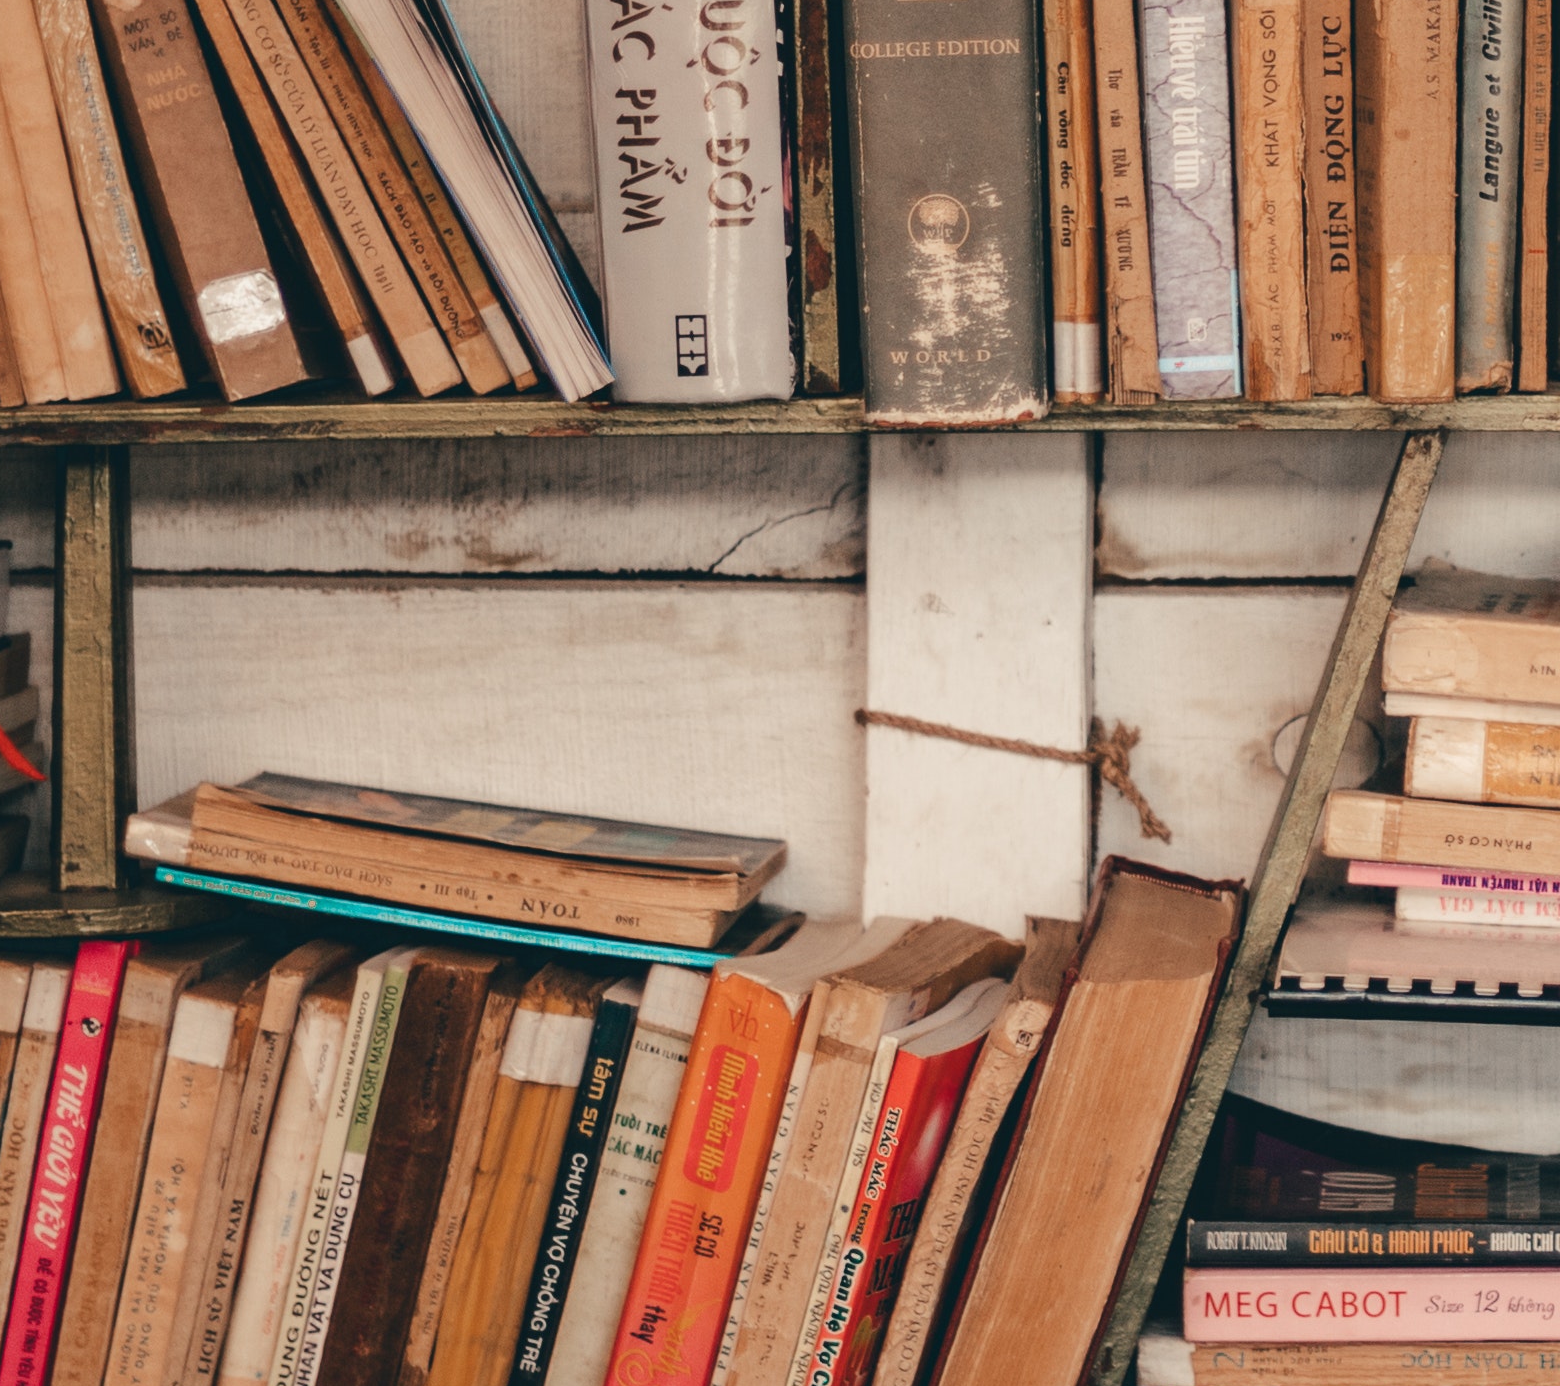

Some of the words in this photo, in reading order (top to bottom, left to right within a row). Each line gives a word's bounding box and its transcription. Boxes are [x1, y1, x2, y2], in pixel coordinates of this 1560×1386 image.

[850, 41, 931, 59] COLLEGE
[937, 38, 1020, 57] EDITION
[1320, 14, 1347, 77] LỰC
[1170, 71, 1206, 100] về
[1261, 48, 1281, 107] VỌNG
[1483, 72, 1501, 96] et
[1171, 105, 1205, 145] trái
[1261, 118, 1280, 167] KHÁT
[1318, 93, 1351, 183] ĐỘNG
[611, 83, 692, 235] PHẨM
[1172, 148, 1207, 189] tim
[1477, 107, 1503, 202] Langue
[702, 130, 775, 229] ĐỜI
[1321, 199, 1354, 274] ĐIỆN
[890, 349, 991, 364] WORLD
[518, 895, 582, 923] TOÁN
[365, 983, 400, 1066] MASSUMOTO
[52, 1059, 98, 1130] THẾ
[351, 1066, 380, 1127] TAKASHI
[586, 1055, 615, 1102] tâm
[714, 1049, 749, 1103] Minh
[574, 1103, 601, 1138] sự
[41, 1123, 84, 1187] GIỚI
[551, 1150, 593, 1232] CHUYỆN
[29, 1185, 72, 1251] YÊU
[283, 1225, 321, 1318] ĐƯỜNG
[304, 1166, 334, 1219] NÉT
[848, 1201, 873, 1246] trong
[1347, 1227, 1367, 1253] CÓ
[1433, 1228, 1474, 1254] PHÚC
[543, 1230, 571, 1263] VỢ
[527, 1262, 568, 1335] CHỒNG
[833, 1245, 866, 1304] Quan
[821, 1301, 851, 1335] Hệ
[1203, 1290, 1278, 1318] MEG
[1290, 1289, 1407, 1317] CABOT
[1423, 1292, 1464, 1314] Size
[1473, 1289, 1498, 1313] 12
[1506, 1294, 1555, 1320] không
[518, 1333, 548, 1375] TRẺ
[811, 1336, 841, 1369] Vợ
